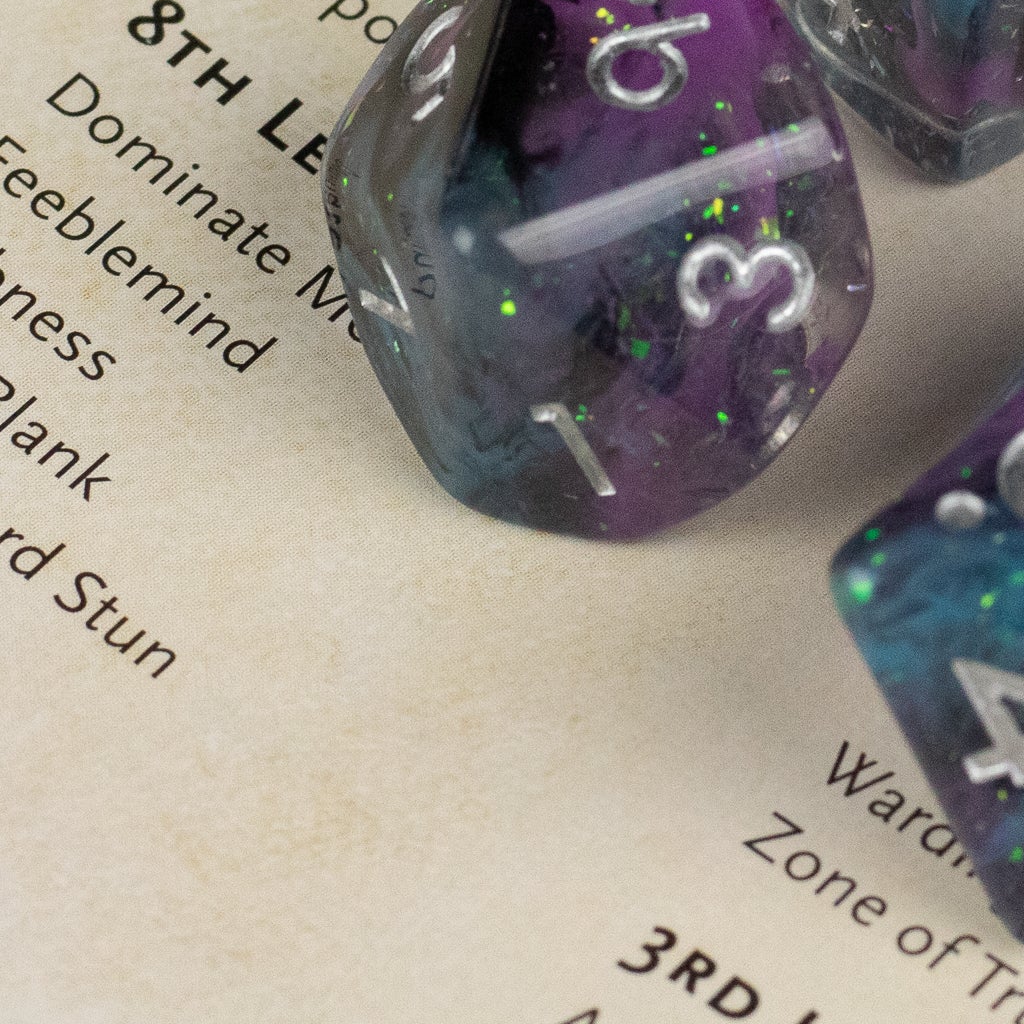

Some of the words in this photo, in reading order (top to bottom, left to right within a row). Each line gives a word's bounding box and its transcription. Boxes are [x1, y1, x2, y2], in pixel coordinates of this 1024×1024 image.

[45, 71, 292, 275] Dominate
[0, 246, 117, 382] ness
[677, 234, 818, 336] 3
[53, 571, 177, 679] Stun
[825, 739, 978, 879] Ward
[741, 811, 889, 928] Zone
[896, 924, 983, 971] of
[615, 925, 761, 1020] 3RD
